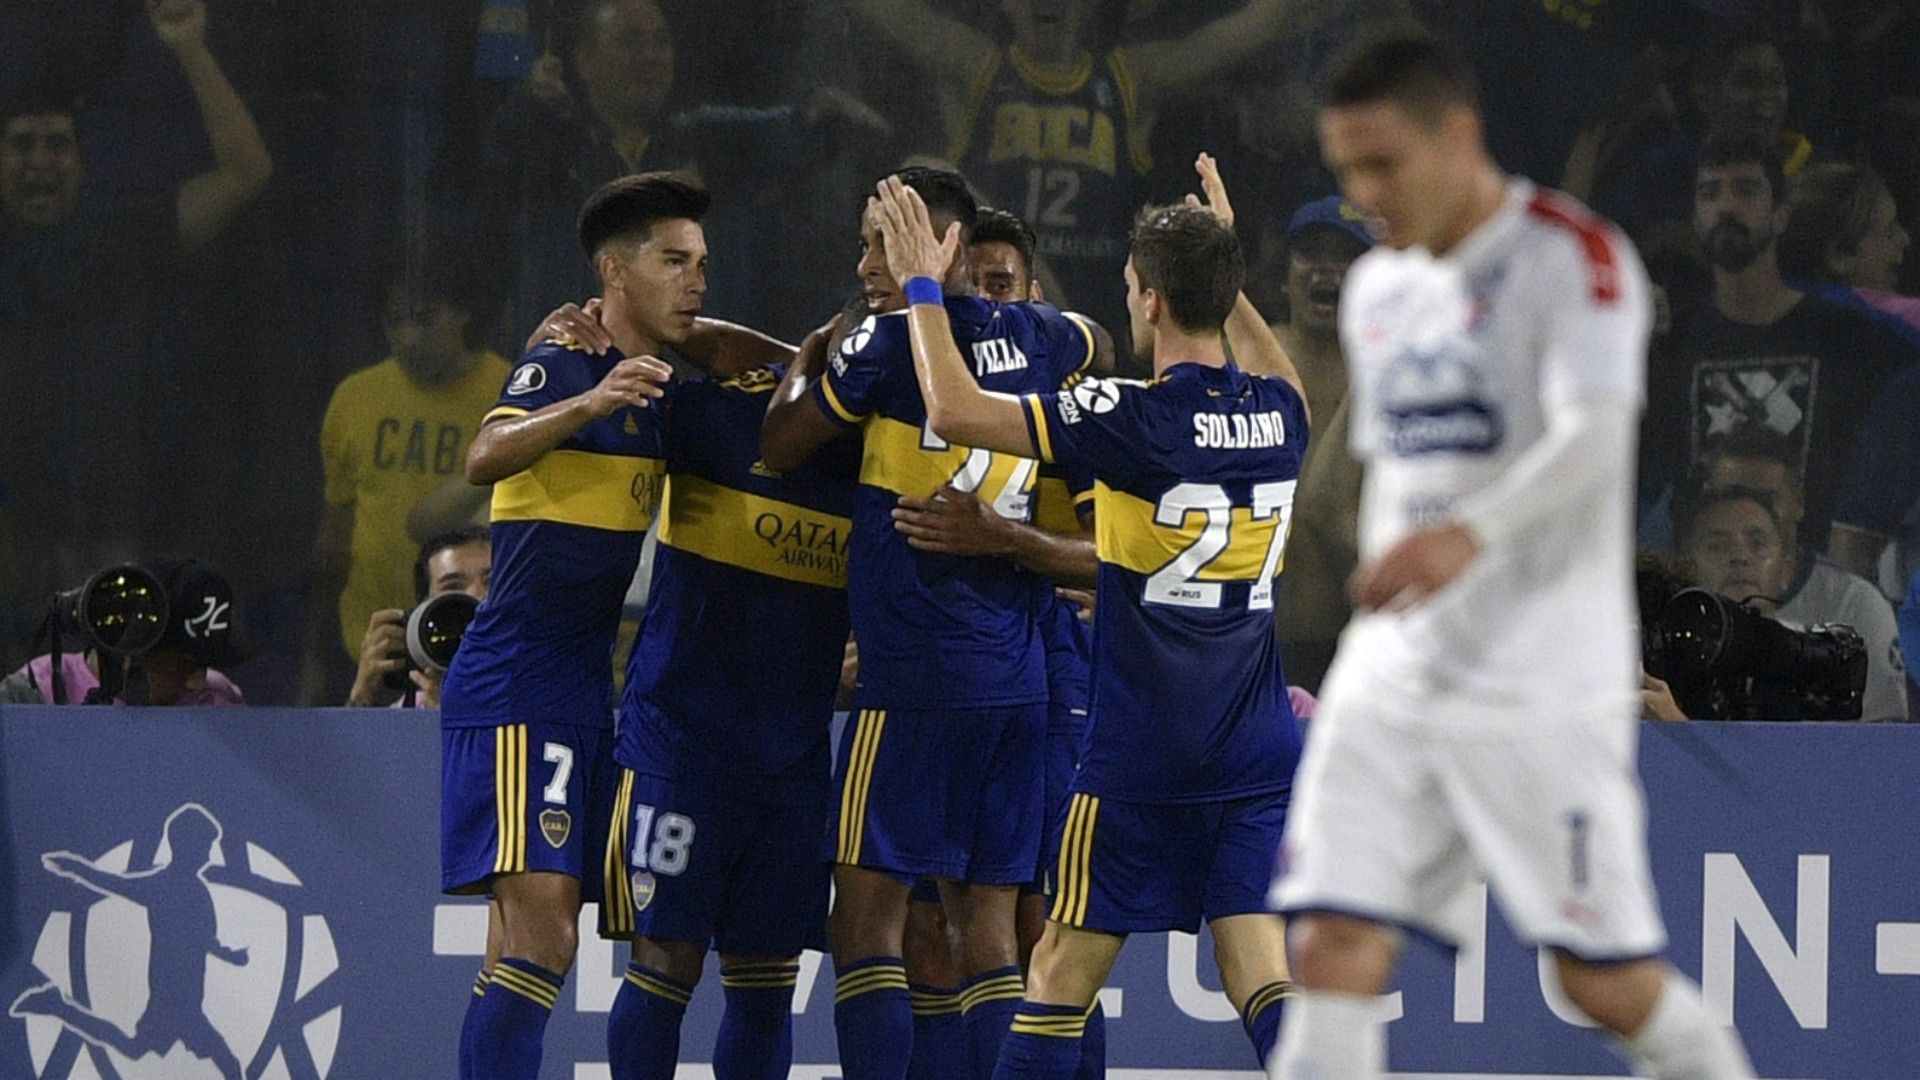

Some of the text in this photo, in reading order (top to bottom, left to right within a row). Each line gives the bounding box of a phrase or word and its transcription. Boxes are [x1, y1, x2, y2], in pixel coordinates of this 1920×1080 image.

[988, 101, 1117, 177] BOCA
[1024, 167, 1081, 228] 12
[970, 336, 1029, 378] VILLA
[1193, 410, 1286, 449] SOLDANO
[1142, 480, 1298, 611] 27
[543, 741, 574, 805] 7
[631, 803, 697, 877] 18
